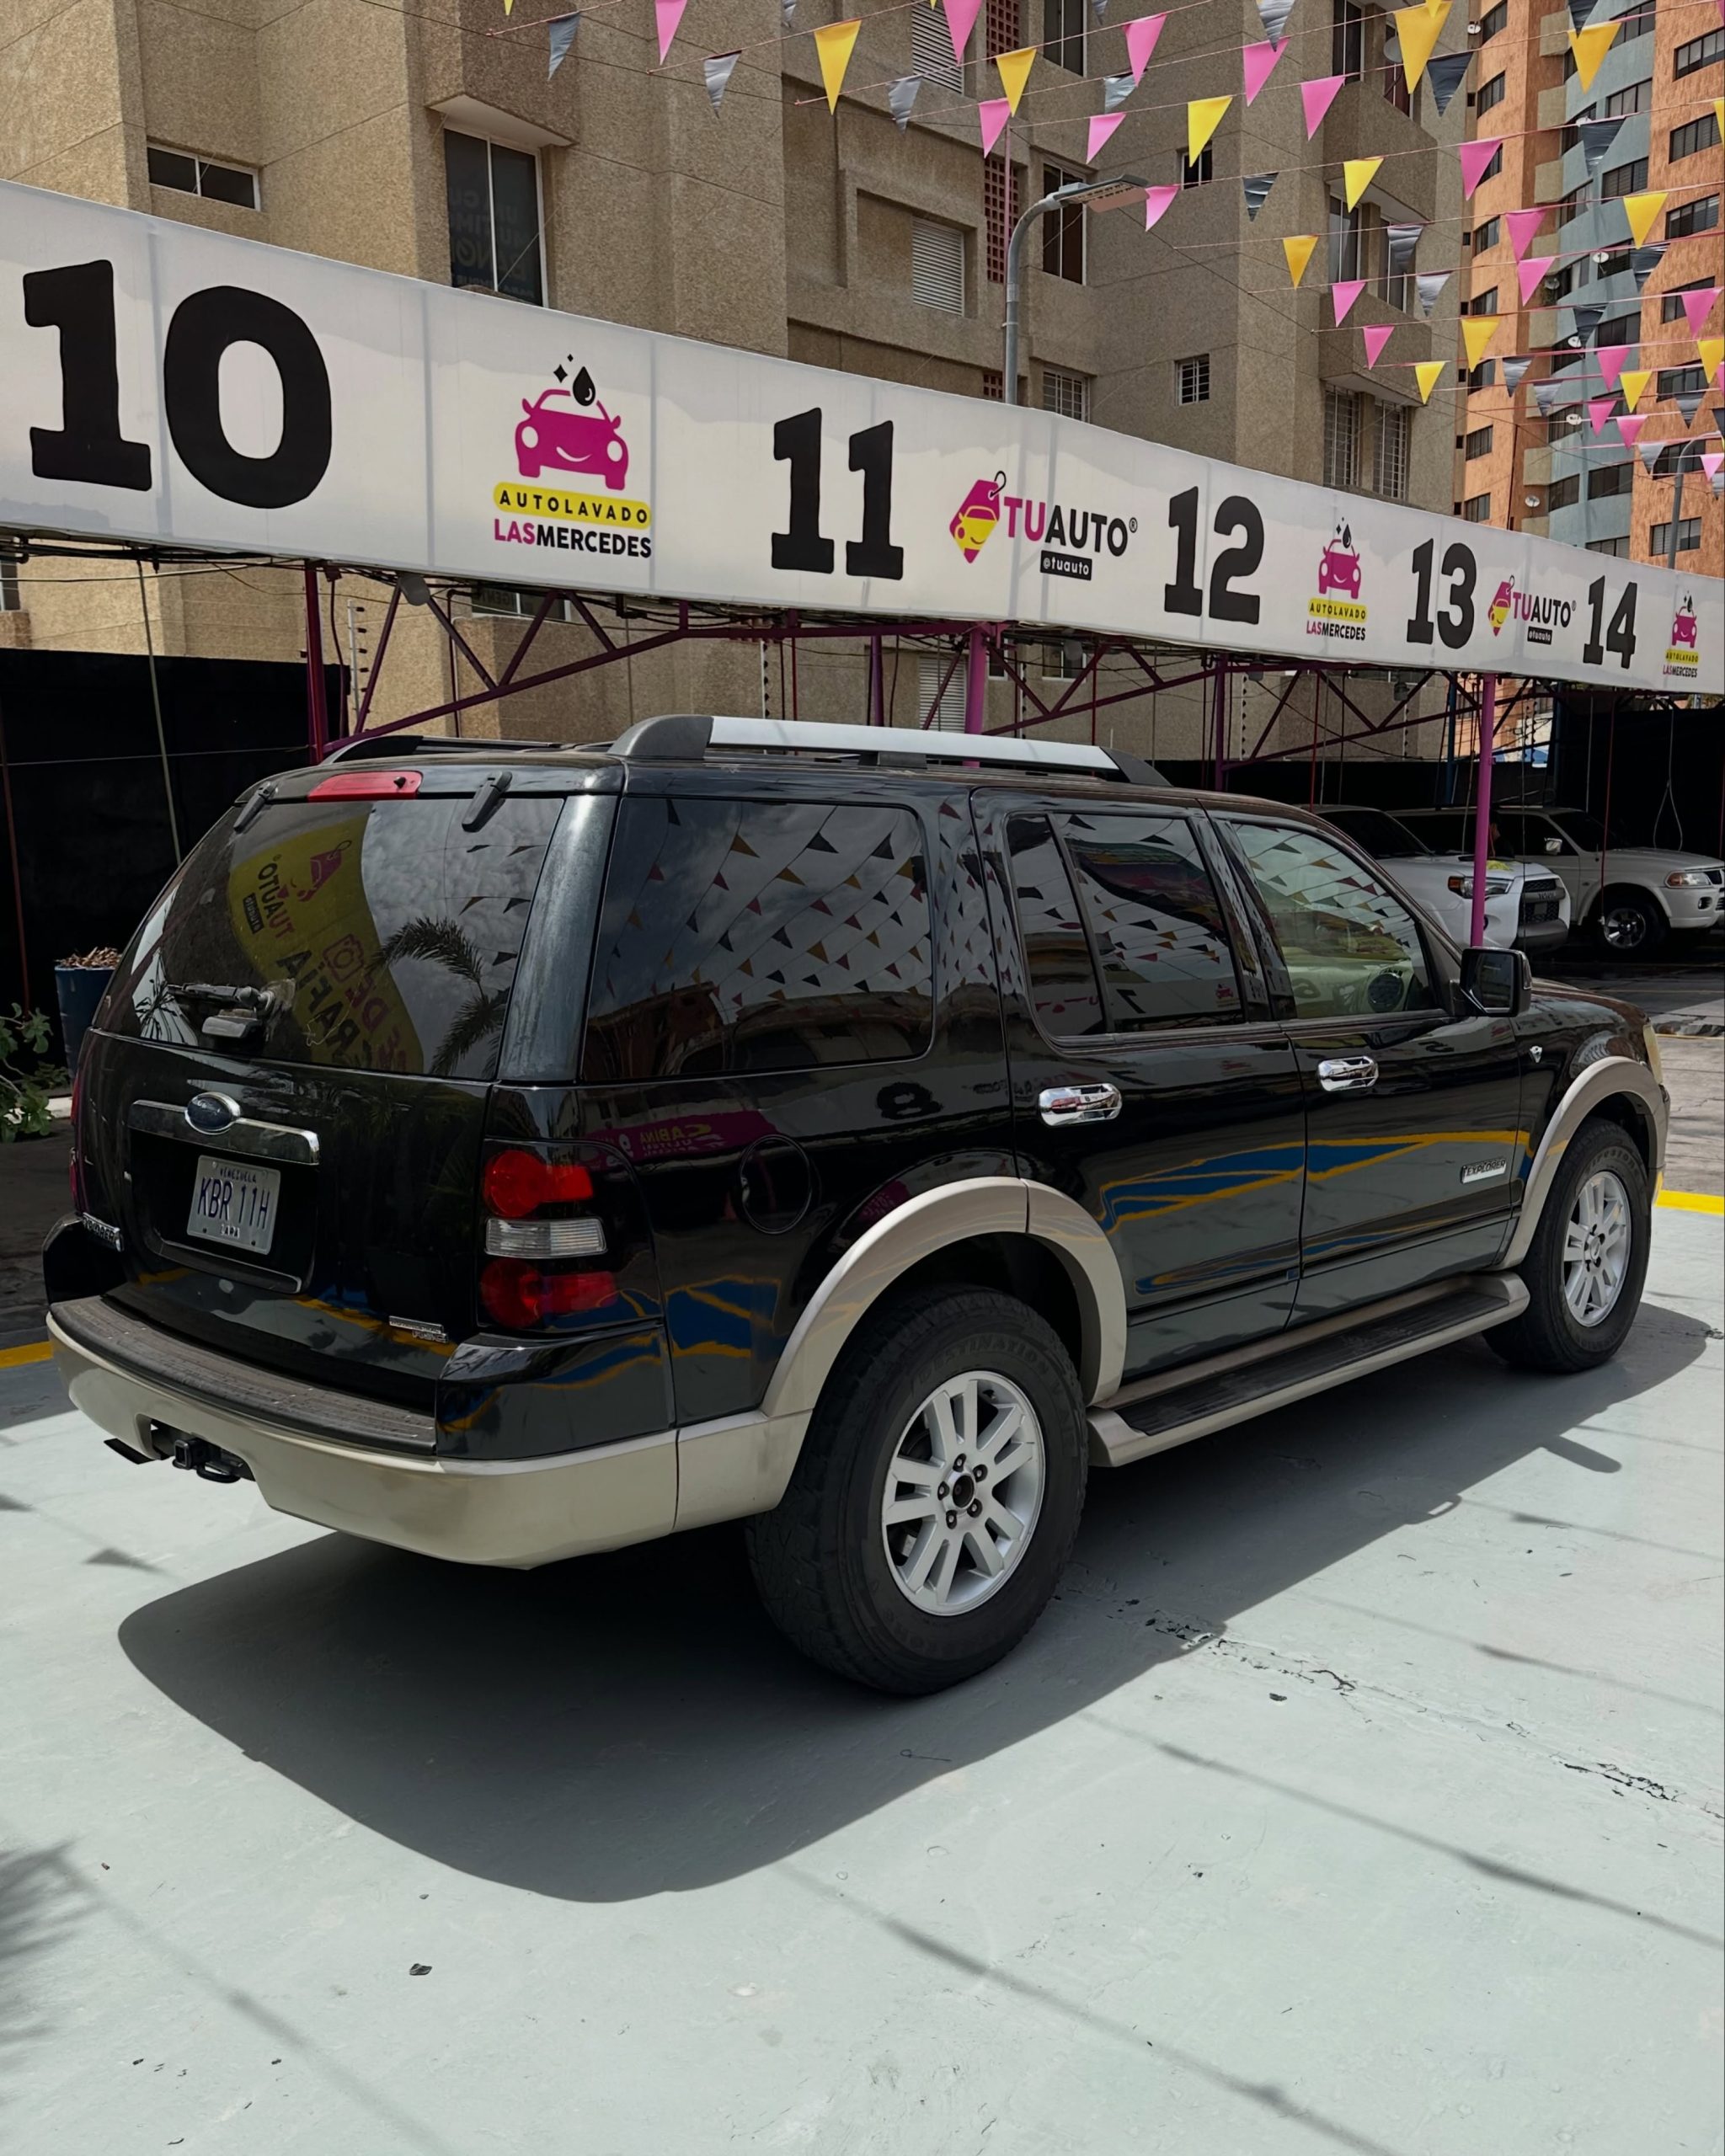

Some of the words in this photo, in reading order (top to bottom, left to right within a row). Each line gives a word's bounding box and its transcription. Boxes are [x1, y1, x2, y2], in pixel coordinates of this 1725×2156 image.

[23, 259, 333, 509] 10
[500, 490, 648, 524] AUTOLAVADO
[772, 407, 904, 580] 11
[1043, 557, 1090, 575] @tuauto
[1164, 485, 1264, 625] 12
[1310, 602, 1366, 620] AUTOLAVADO
[1407, 538, 1477, 649] 13
[1583, 575, 1637, 669] 14
[1665, 652, 1699, 663] AUTOLAVADO
[220, 1166, 257, 1183] VENEZUELA
[1466, 1158, 1507, 1177] EXPLORER
[197, 1177, 233, 1220] KBR
[238, 1184, 270, 1230] 11H
